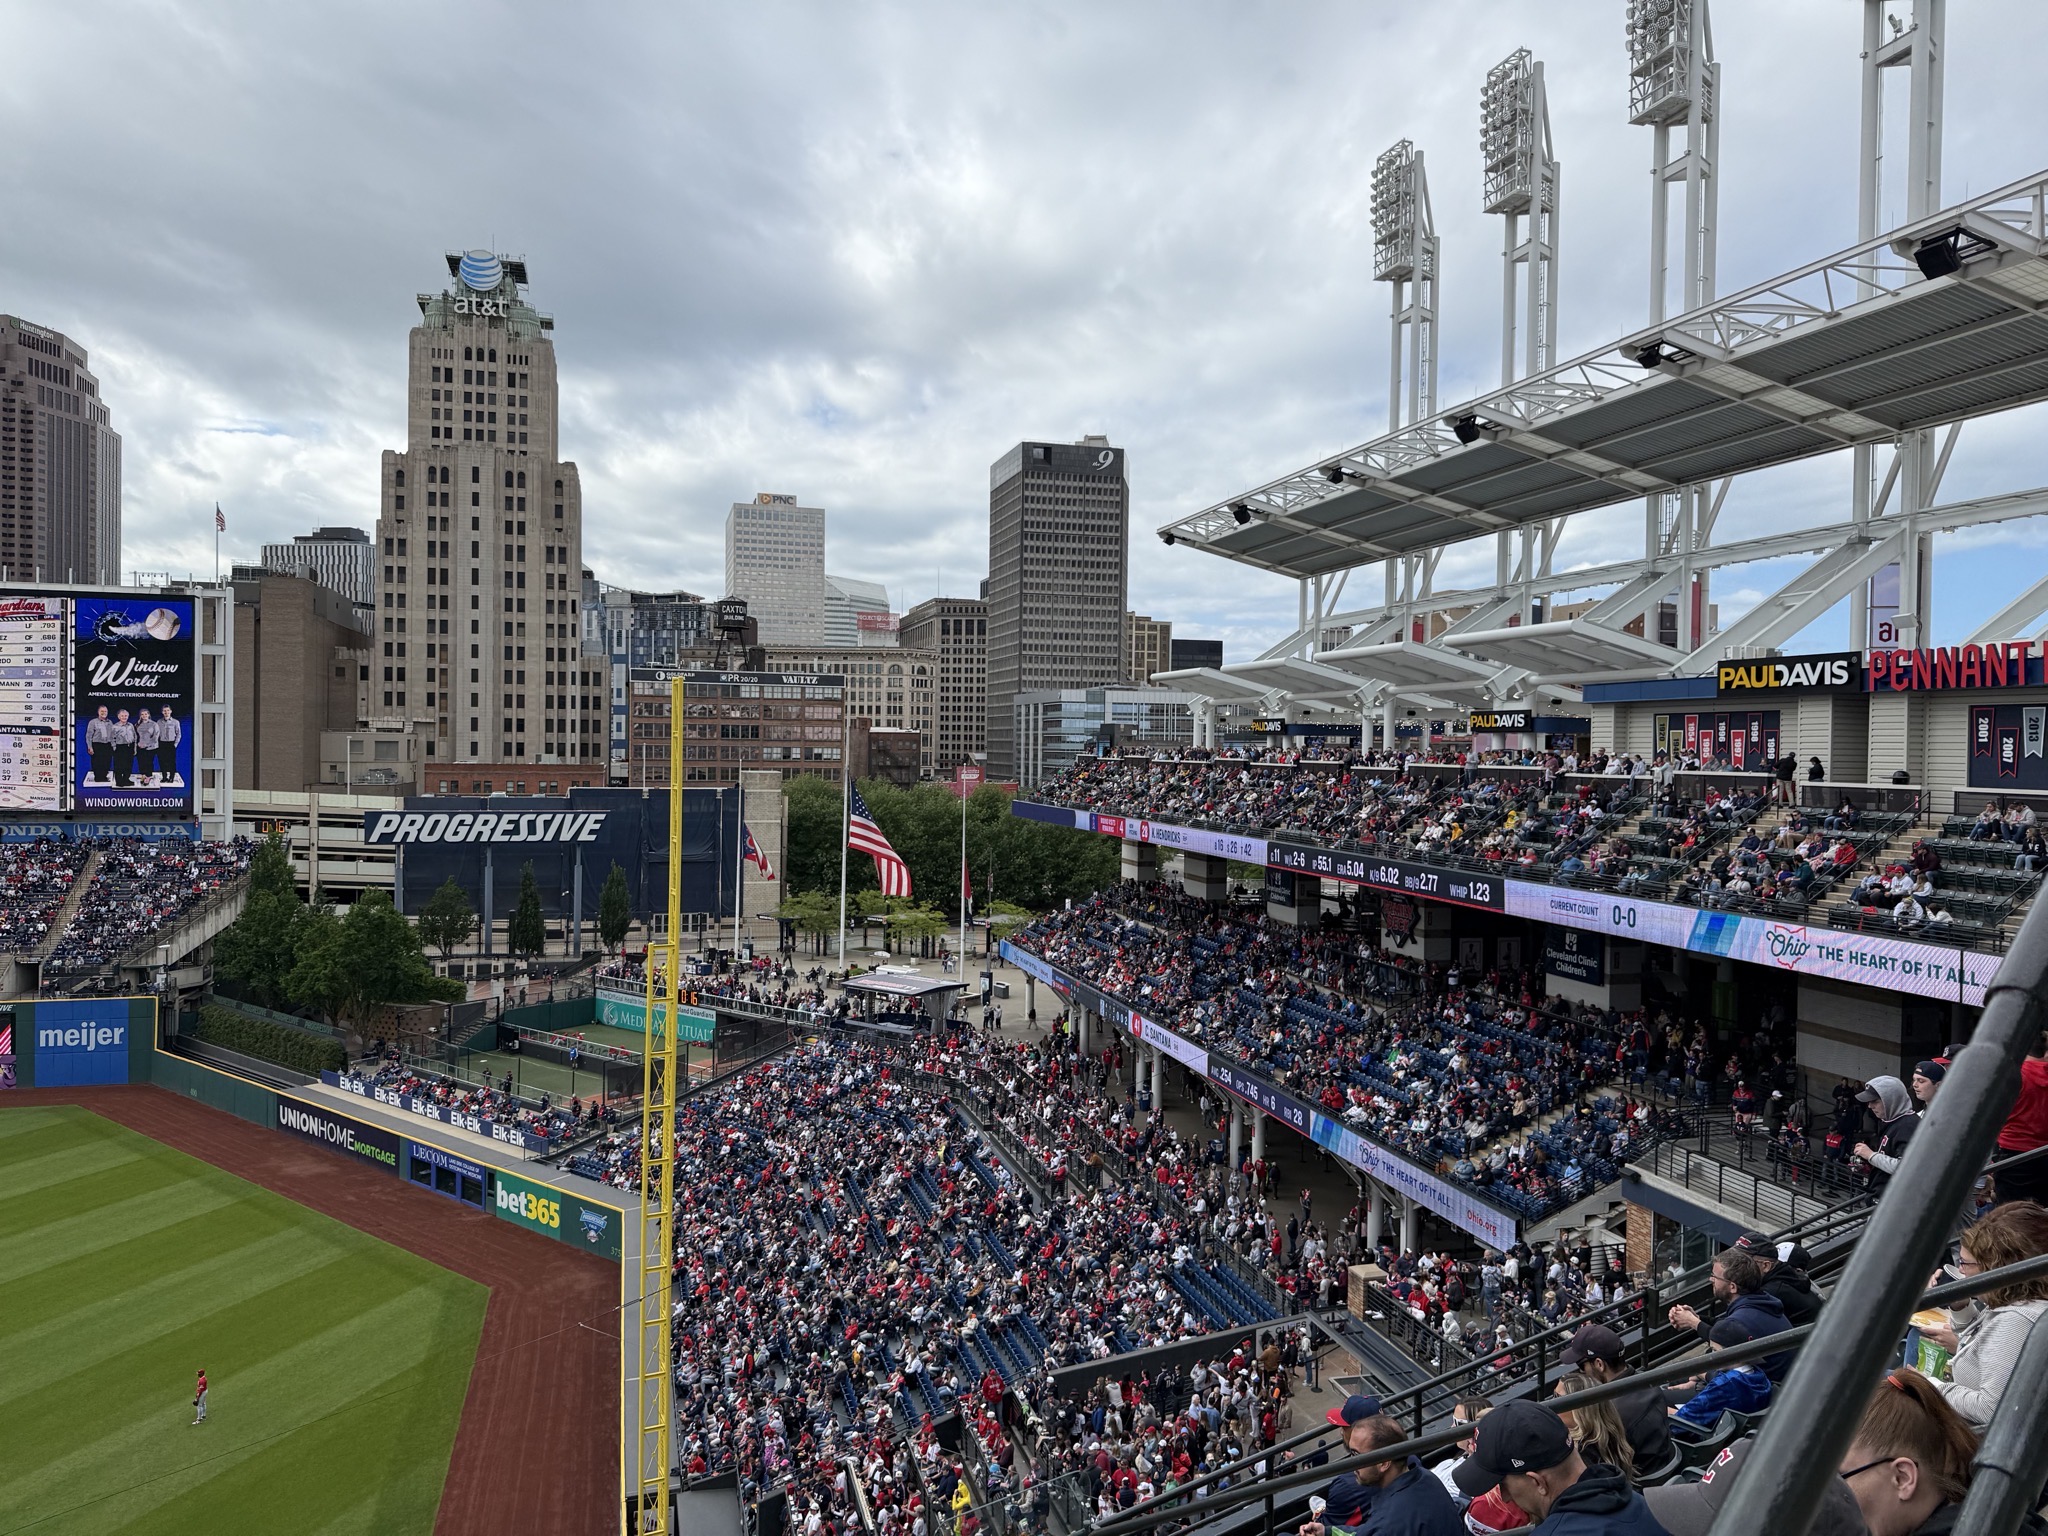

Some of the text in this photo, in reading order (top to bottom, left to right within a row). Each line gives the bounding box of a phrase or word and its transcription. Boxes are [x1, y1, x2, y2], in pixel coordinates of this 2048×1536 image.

[454, 294, 508, 317] at&t
[20, 320, 54, 340] Huntington
[1097, 450, 1114, 470] 9
[772, 495, 794, 505] PNC
[88, 654, 179, 687] Window
[728, 673, 739, 682] PR
[1869, 641, 2035, 692] PENNANT
[782, 675, 819, 684] VAULTZ
[1978, 717, 1989, 742] 2001
[2028, 717, 2040, 742] 2013
[2002, 737, 2014, 763] 2007
[84, 797, 184, 808] WINDOWWORLD.COM
[99, 825, 190, 837] HONDA
[368, 813, 607, 843] PROGRESSIVE
[1119, 821, 1124, 833] 4
[1156, 829, 1181, 843] HENDRICKS
[1230, 841, 1238, 854] 26
[1243, 843, 1251, 856] 42
[1274, 849, 1280, 862] 11
[1293, 851, 1306, 867] 2-6
[1312, 860, 1318, 869] IP
[1317, 857, 1332, 871] 55.1
[1337, 864, 1347, 875] ERA
[1346, 860, 1364, 878] 5.04
[1369, 868, 1380, 882] K/9
[1380, 865, 1399, 885] 6.02
[1404, 875, 1420, 890] BB/9
[1420, 872, 1438, 892] 2.77
[1449, 883, 1467, 898] WHIP
[1469, 881, 1490, 902] 1.23
[1550, 899, 1598, 917] CURRENT COUNT
[1612, 905, 1637, 928] 0-0
[1546, 947, 1598, 968] Cleveland Clinic
[1766, 930, 1943, 980] Ohio THE HEART OF IT
[1556, 961, 1587, 977] Children's
[690, 1009, 714, 1019] Guardians
[39, 1021, 125, 1051] meijer
[677, 1024, 710, 1041] UTUAL
[1134, 1018, 1140, 1033] 41
[1150, 1025, 1172, 1050] SANTANA
[1219, 1068, 1232, 1086] .254
[1235, 1079, 1245, 1091] OPS
[1244, 1082, 1258, 1100] .745
[1262, 1094, 1270, 1105] HR
[1270, 1095, 1276, 1111] 6
[1293, 1108, 1303, 1126] 28
[354, 1140, 396, 1166] MORTGAGE
[1359, 1141, 1380, 1170] Ohio
[1382, 1160, 1395, 1177] THE
[1396, 1170, 1418, 1192] HEART
[1418, 1182, 1429, 1198] OF
[1429, 1188, 1437, 1202] IT
[496, 1180, 560, 1228] bet365
[1466, 1209, 1498, 1237] Ohio.org
[611, 1246, 622, 1257] 375
[1701, 1447, 1734, 1484] C
